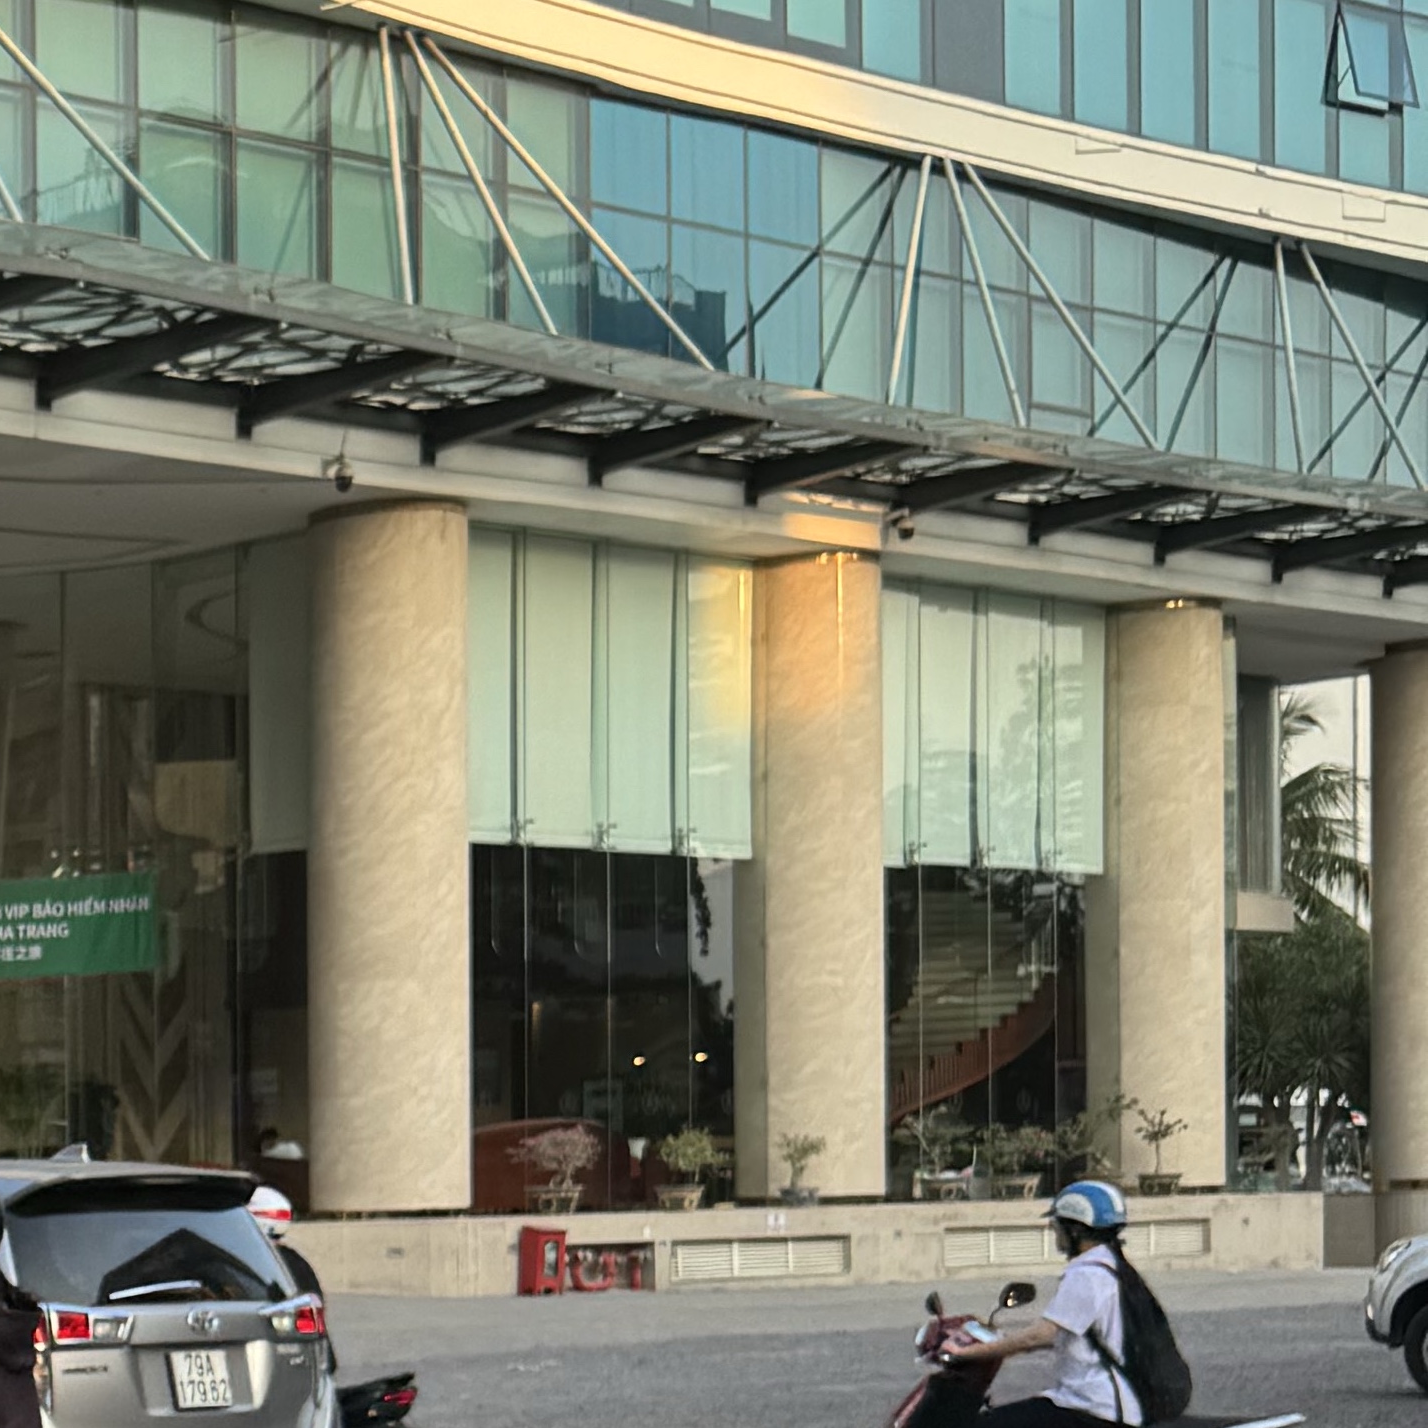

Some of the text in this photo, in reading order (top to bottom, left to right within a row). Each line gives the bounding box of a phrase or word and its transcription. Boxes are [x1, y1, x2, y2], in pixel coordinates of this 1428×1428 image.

[4, 903, 30, 920] VIP
[17, 923, 70, 940] TRANG
[184, 1353, 215, 1377] 79A
